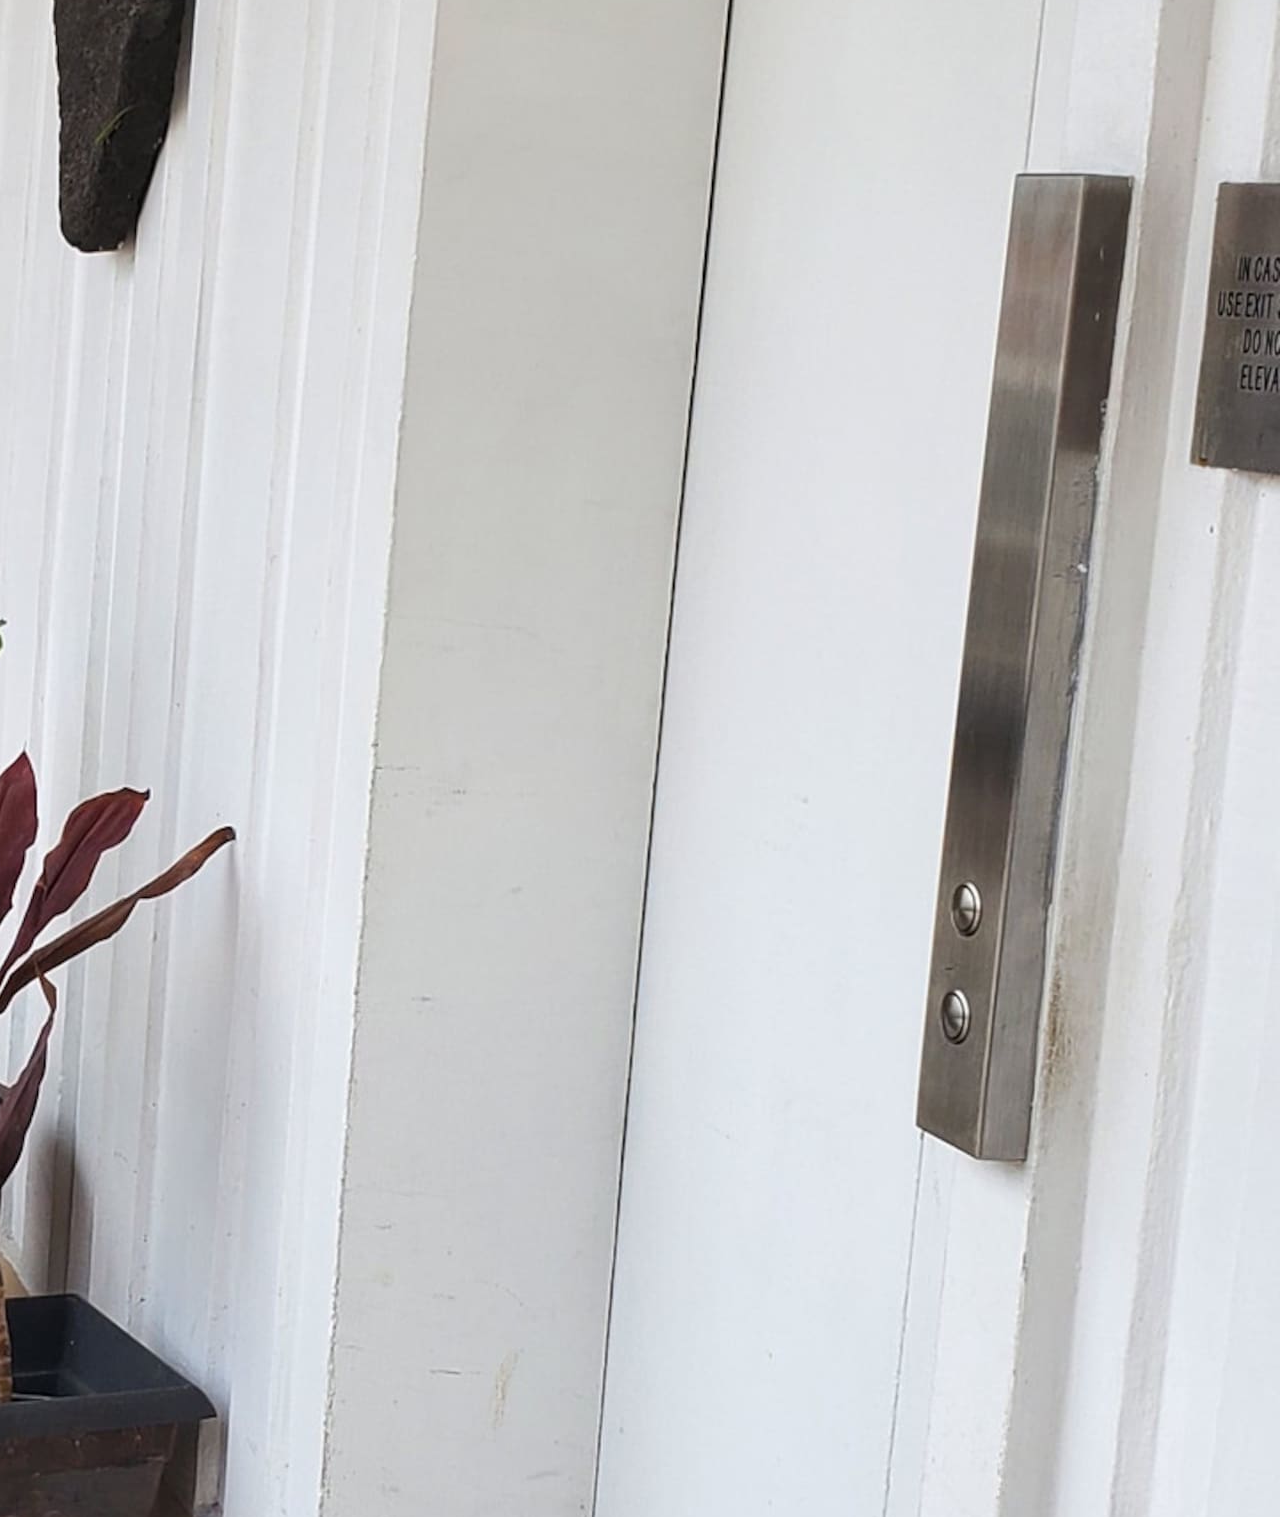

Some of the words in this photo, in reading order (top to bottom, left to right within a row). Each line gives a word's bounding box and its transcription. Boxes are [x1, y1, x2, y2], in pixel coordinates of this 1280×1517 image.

[1237, 256, 1251, 282] IN
[1217, 290, 1243, 318] USE
[1245, 292, 1274, 319] EXIT
[1243, 328, 1261, 354] DO
